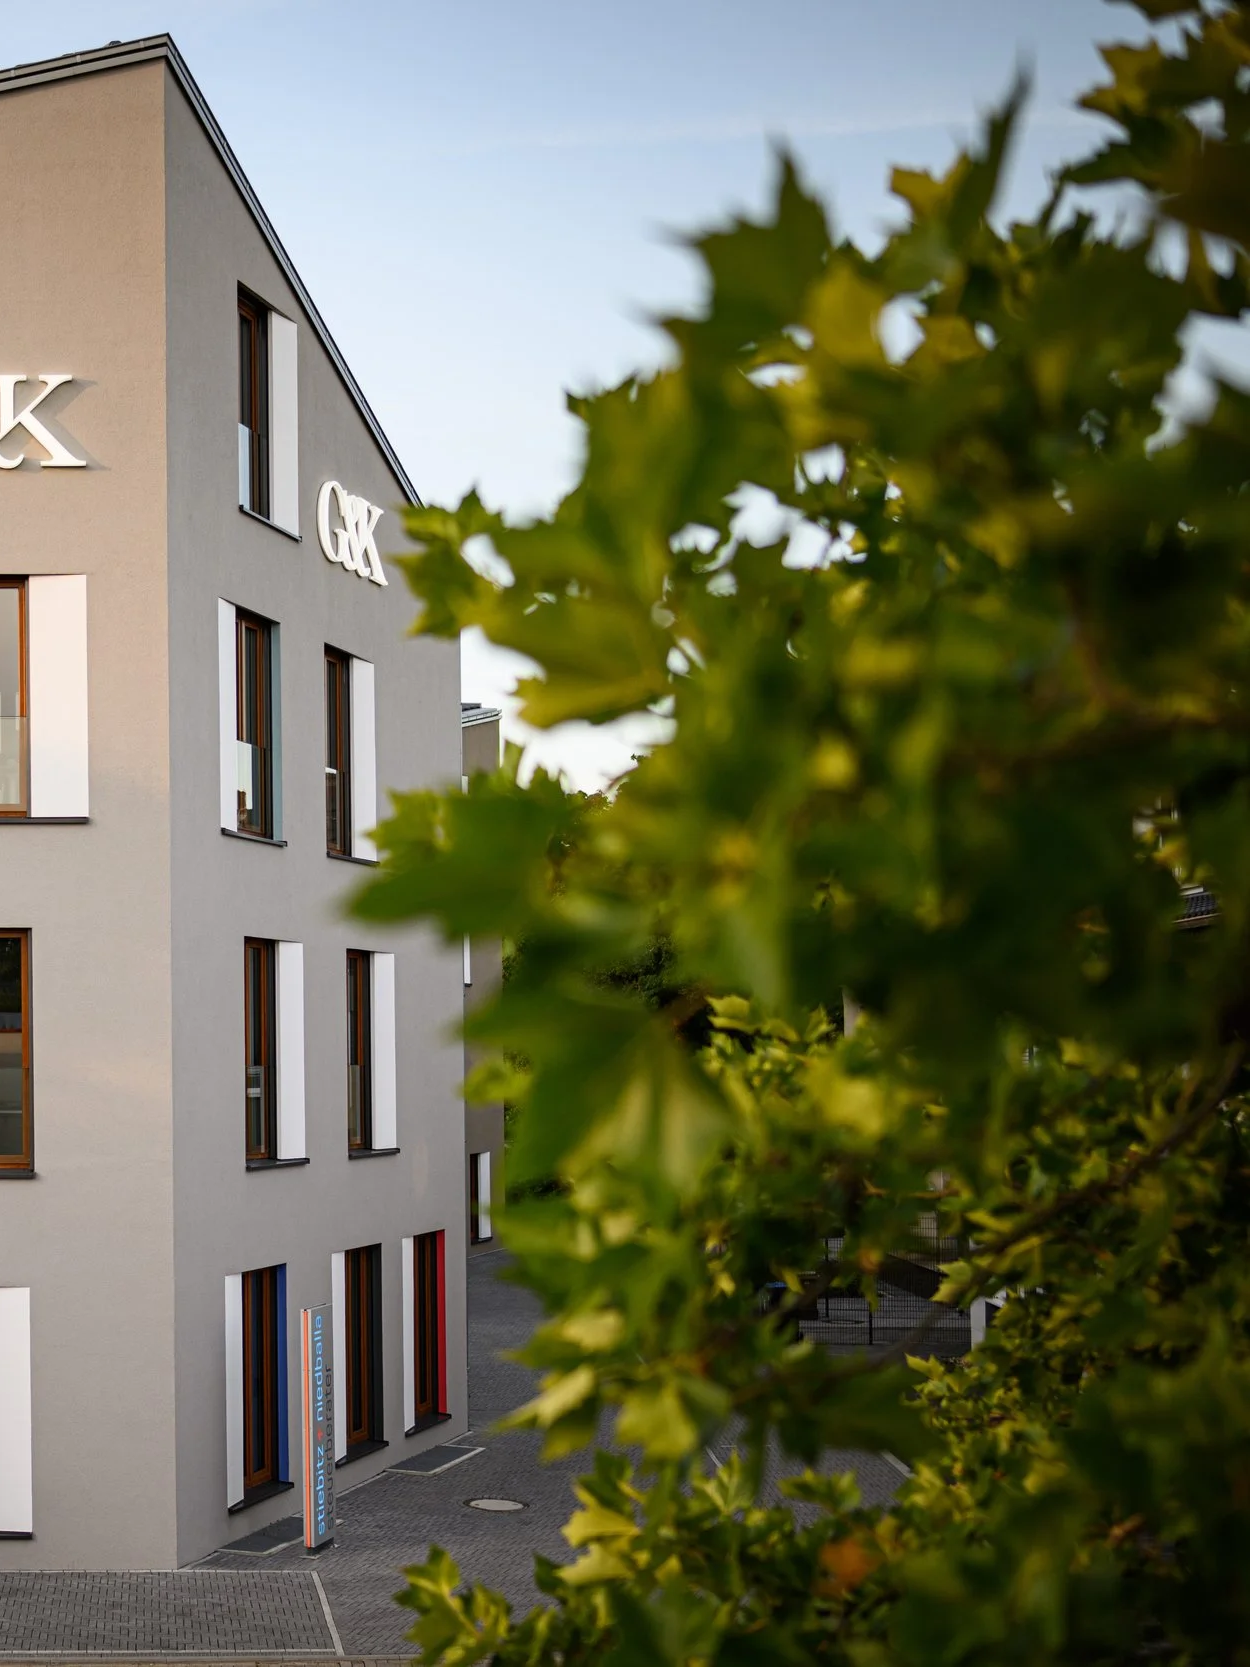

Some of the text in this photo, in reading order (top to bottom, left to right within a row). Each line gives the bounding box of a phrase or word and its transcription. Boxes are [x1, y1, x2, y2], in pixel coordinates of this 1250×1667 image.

[317, 480, 389, 587] G&K
[314, 1315, 323, 1421] niedballa
[316, 1444, 325, 1535] stiebitz
[325, 1366, 333, 1529] steuerberater
